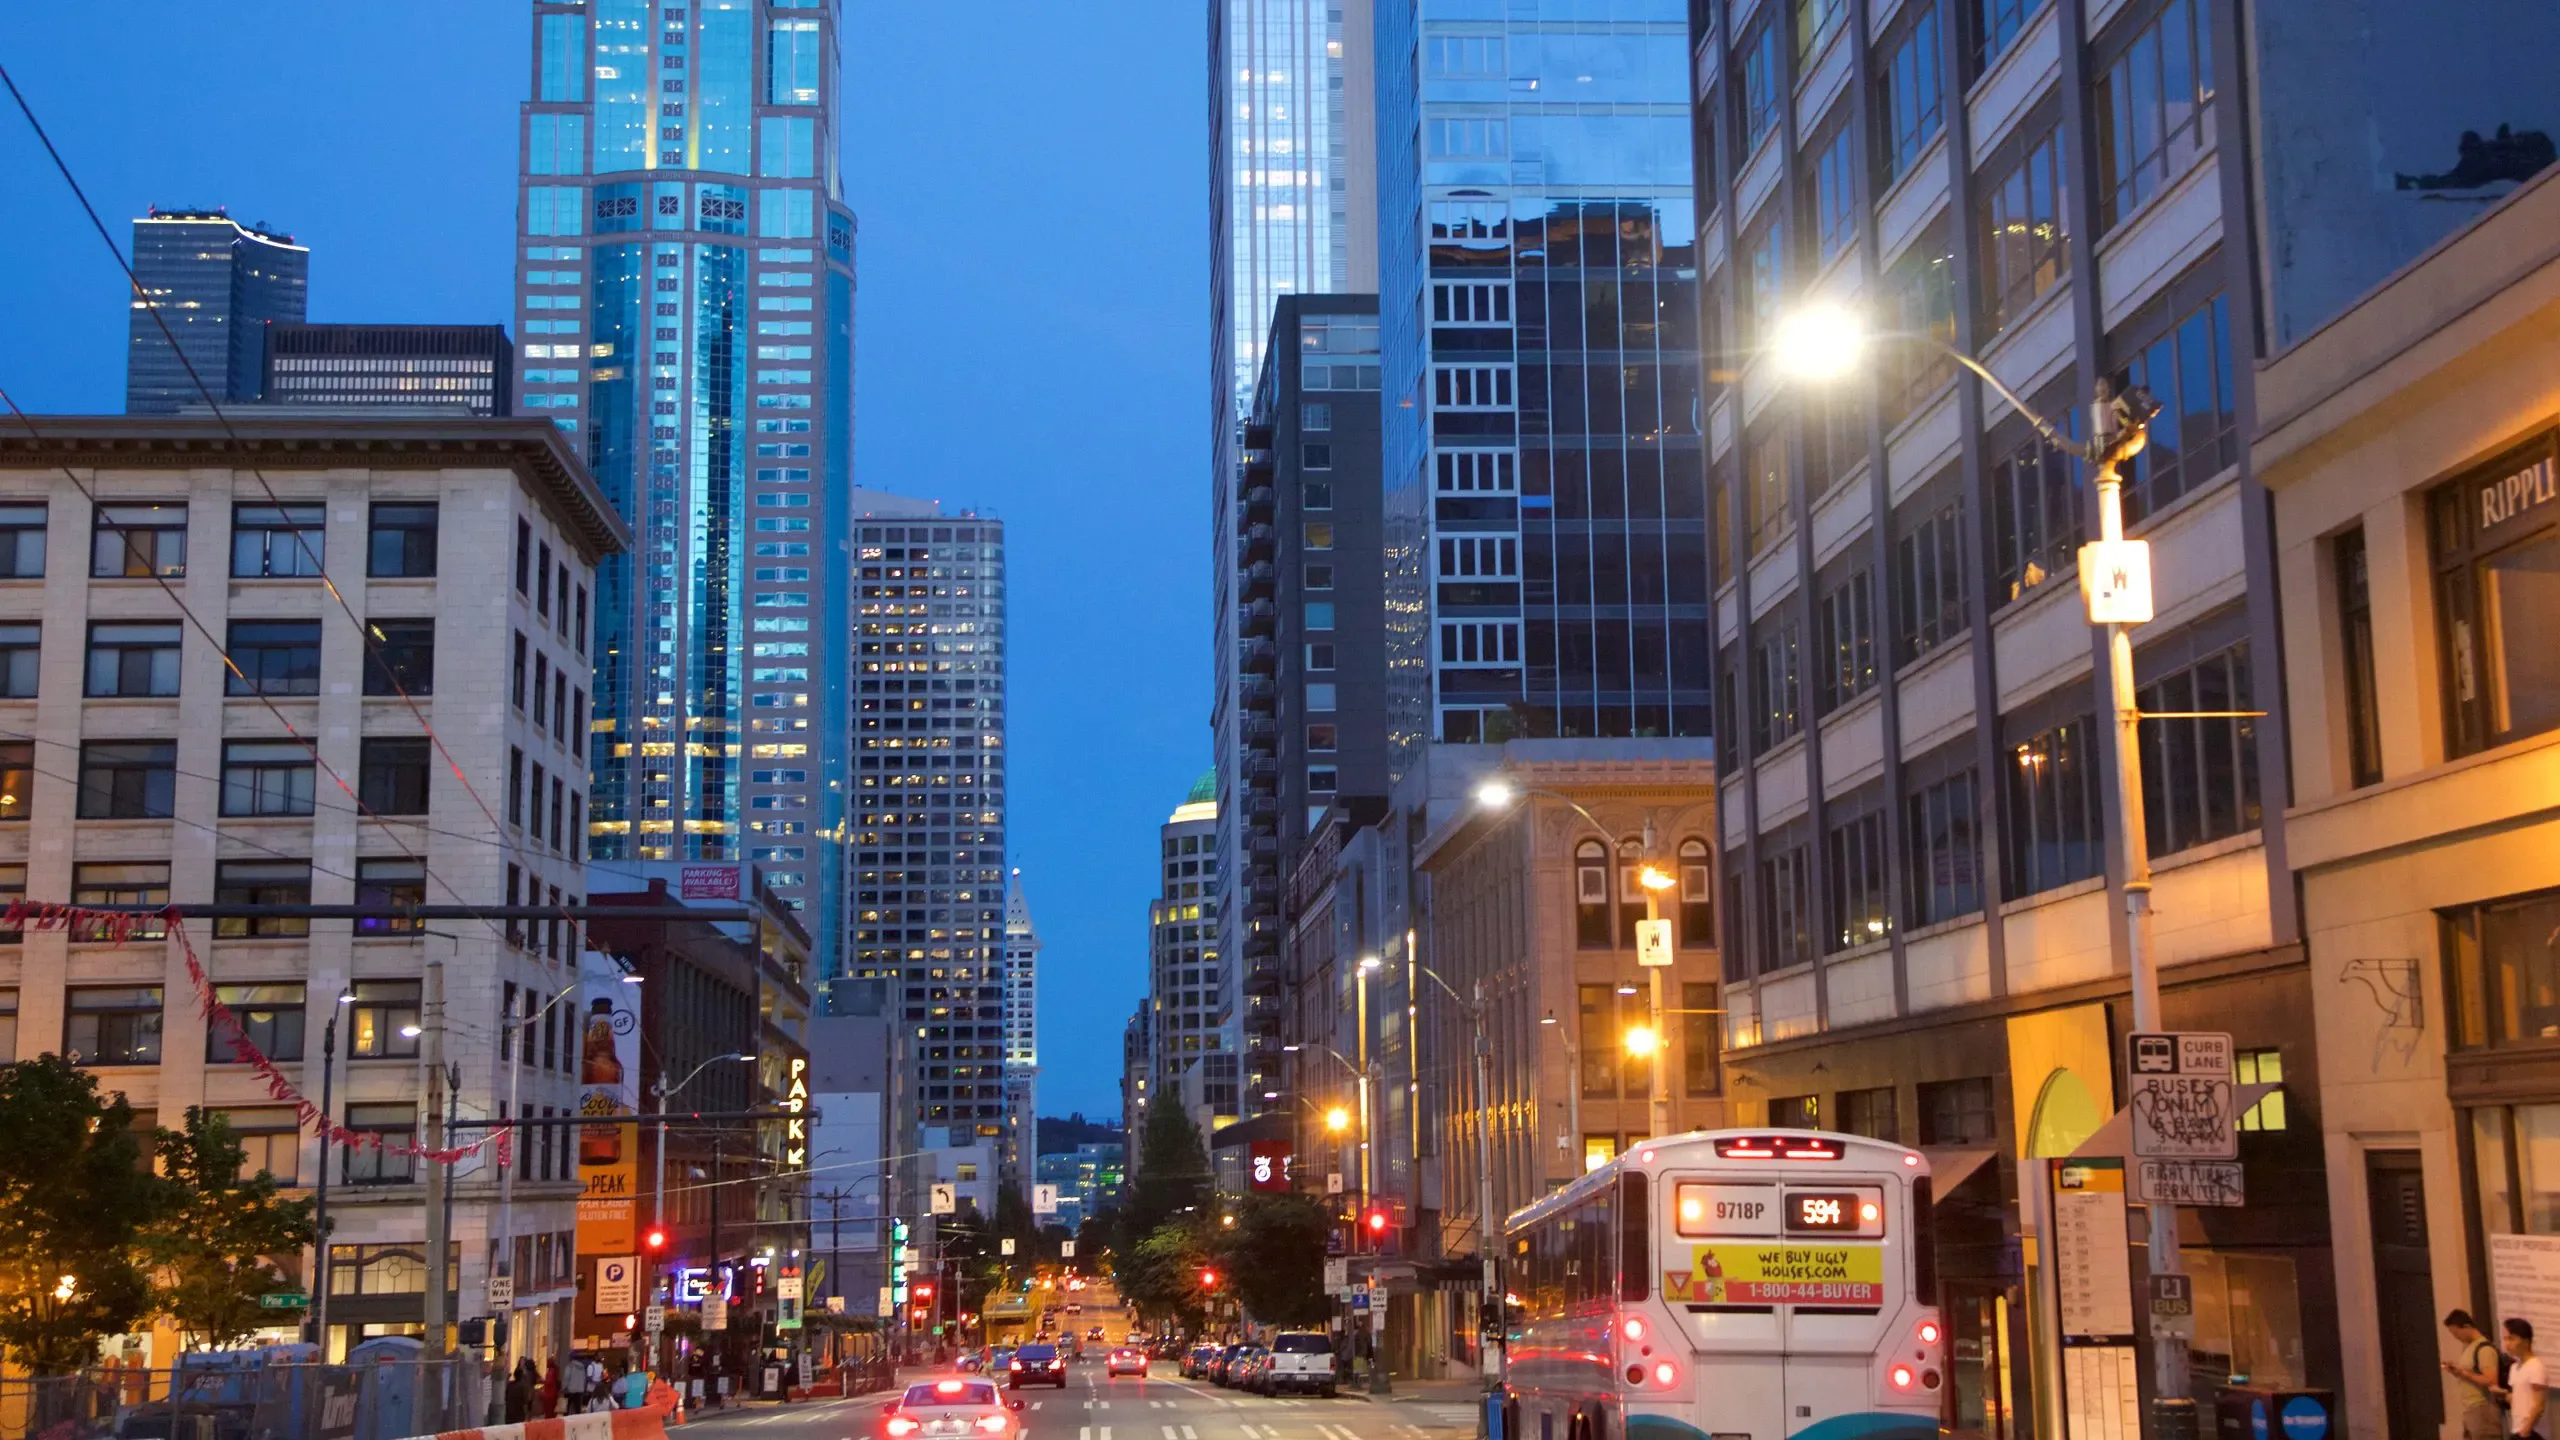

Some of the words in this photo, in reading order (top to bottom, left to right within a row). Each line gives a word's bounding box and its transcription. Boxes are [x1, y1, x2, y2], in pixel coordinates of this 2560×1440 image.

[684, 869, 723, 878] PARKING
[614, 1017, 629, 1028] GF
[2184, 1041, 2224, 1053] CURB
[2185, 1057, 2223, 1069] LANE
[2147, 1079, 2215, 1094] BUSES
[789, 1059, 808, 1139] PARK
[2155, 1097, 2209, 1112] ONLY
[2147, 1166, 2184, 1181] RIGHT
[2189, 1167, 2232, 1182] TURNS
[591, 1173, 626, 1194] PEAK
[1716, 1202, 1765, 1219] 9718P
[1803, 1199, 1841, 1224] 594
[1758, 1251, 1780, 1263] WE
[1786, 1250, 1811, 1263] BUY
[1815, 1251, 1848, 1264] UGLY
[1762, 1266, 1847, 1279] HOUSES.COM
[491, 1280, 511, 1288] ONE
[1749, 1283, 1872, 1299] 1-800-44-BUYER
[491, 1289, 511, 1297] WAY
[2155, 1299, 2188, 1314] BUS
